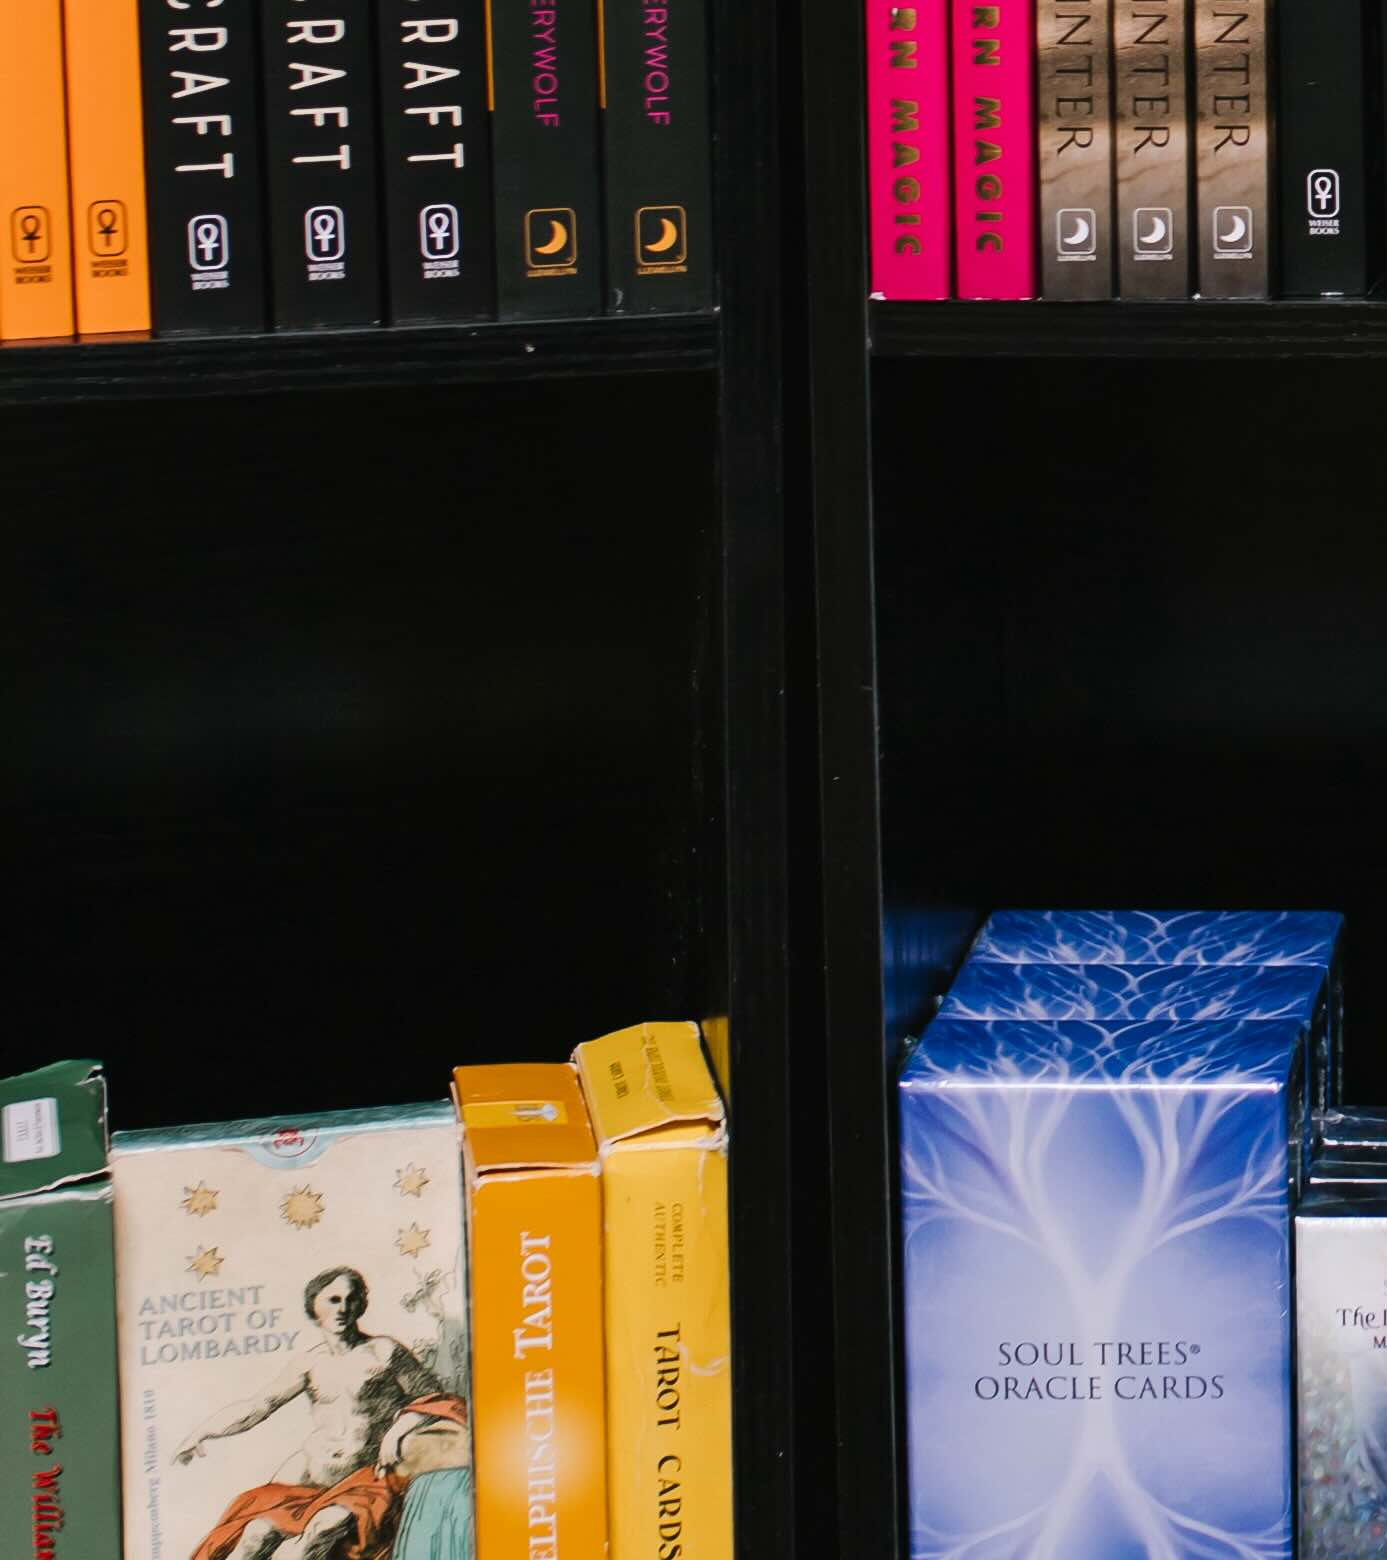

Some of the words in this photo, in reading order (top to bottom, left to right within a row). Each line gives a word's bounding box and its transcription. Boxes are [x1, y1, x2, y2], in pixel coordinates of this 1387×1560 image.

[514, 1232, 552, 1361] TAROT
[974, 1374, 1103, 1402] ORACLE
[1114, 1374, 1226, 1402] CARDS
